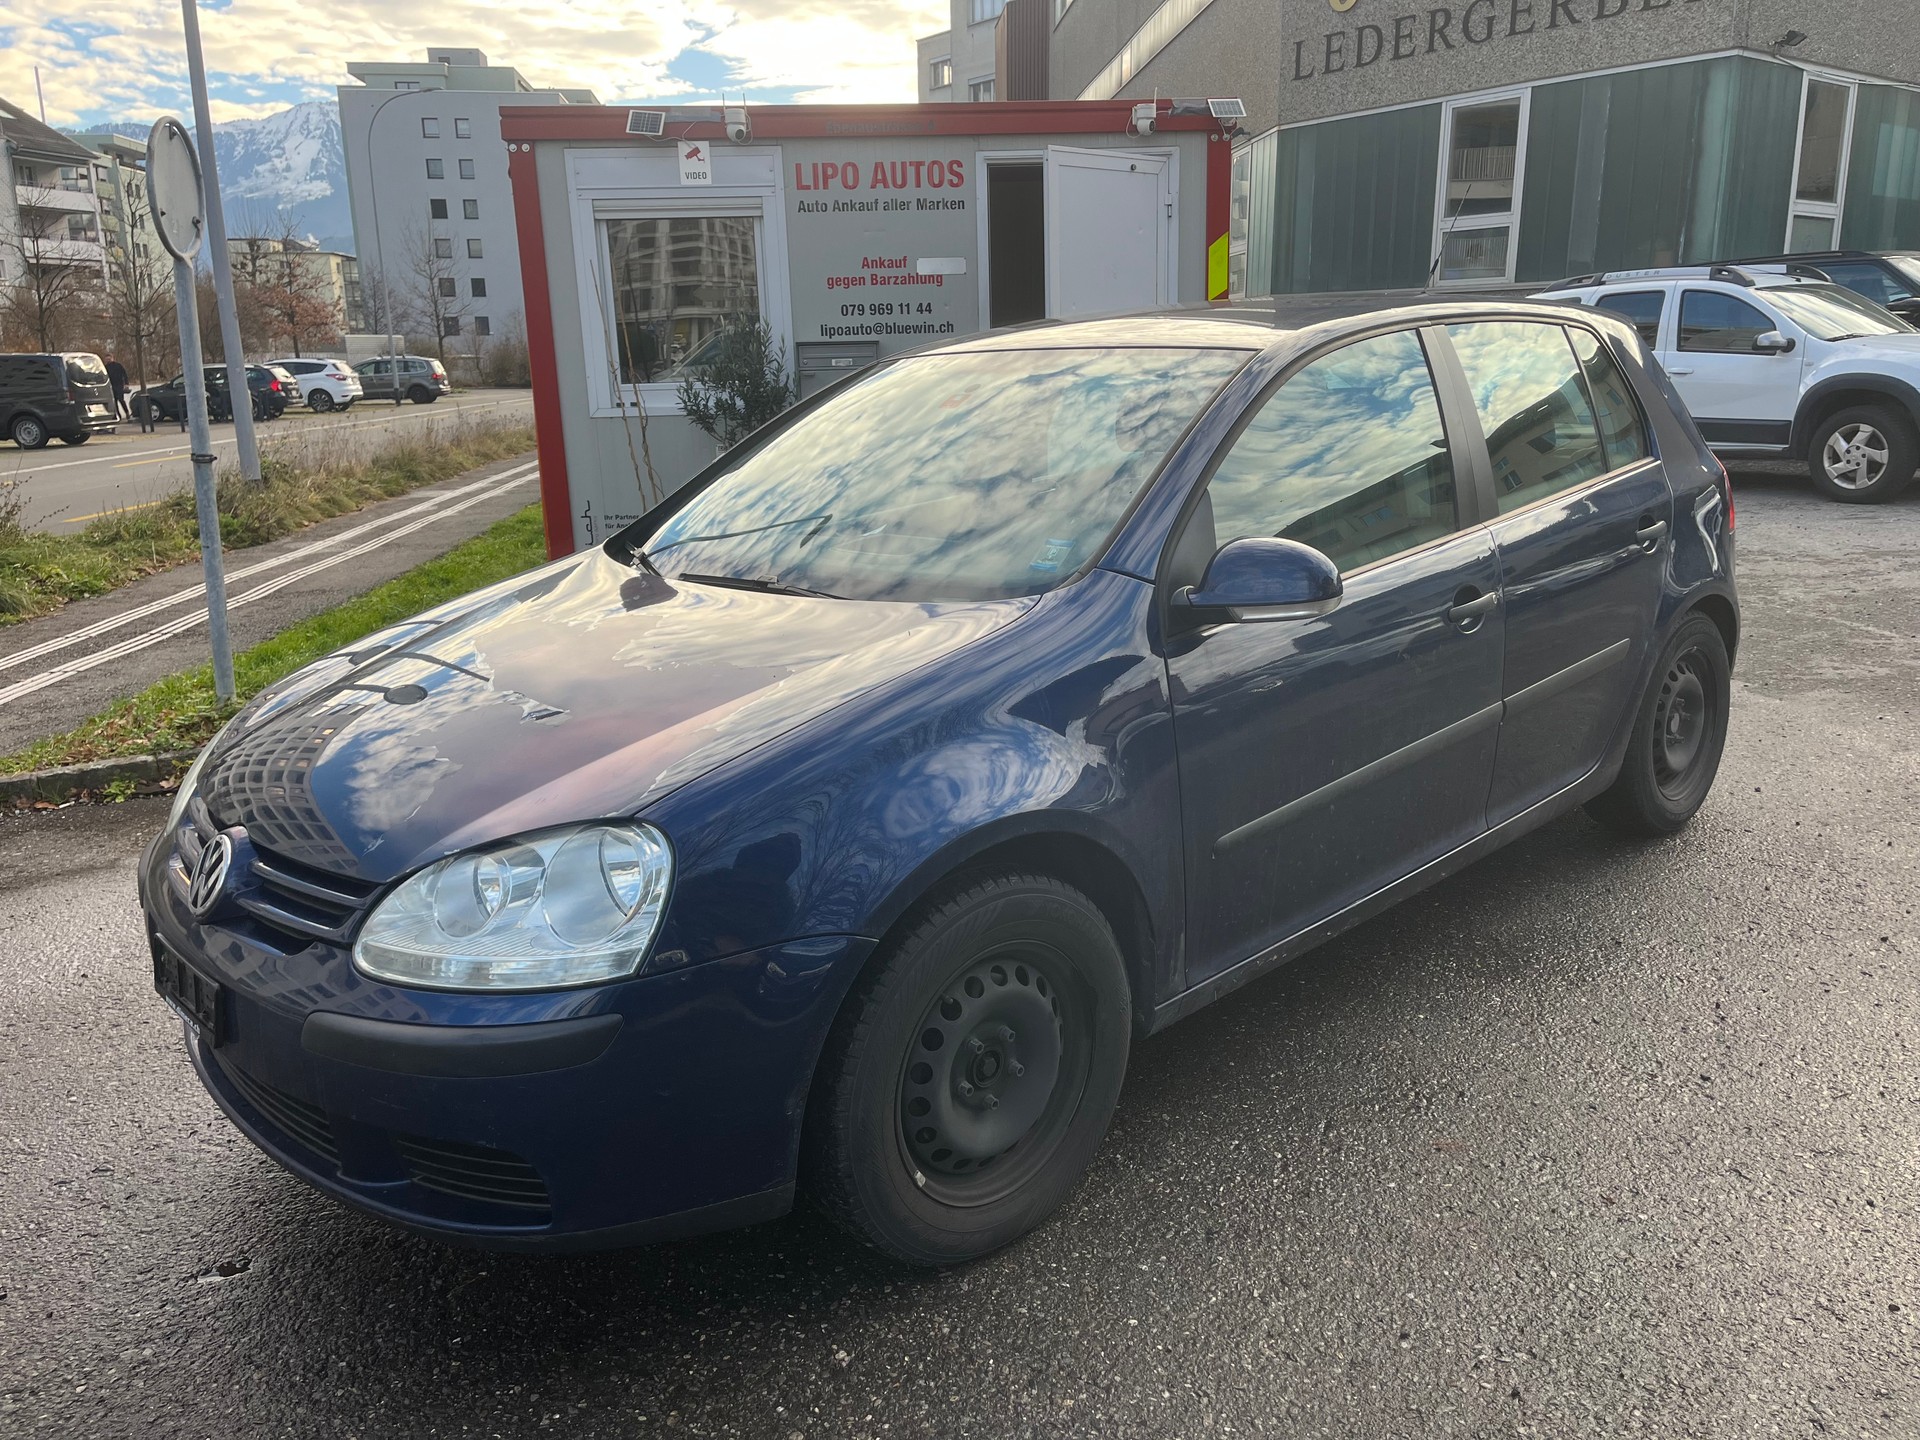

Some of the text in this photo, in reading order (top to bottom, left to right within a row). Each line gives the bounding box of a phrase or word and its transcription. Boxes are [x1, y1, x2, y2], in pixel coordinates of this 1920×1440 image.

[1291, 0, 1702, 81] LEDERGER
[685, 171, 707, 180] VIDEO
[795, 159, 965, 190] LIPO AUTOS
[798, 198, 965, 213] Auto Ankauf aller Marken
[861, 256, 908, 269] Ankauf
[827, 273, 943, 289] gegen Barzahlung
[1606, 270, 1661, 279] DUSTER
[840, 302, 933, 316] 079 969 11 44
[820, 321, 954, 339] lipoauto@bluewin.ch
